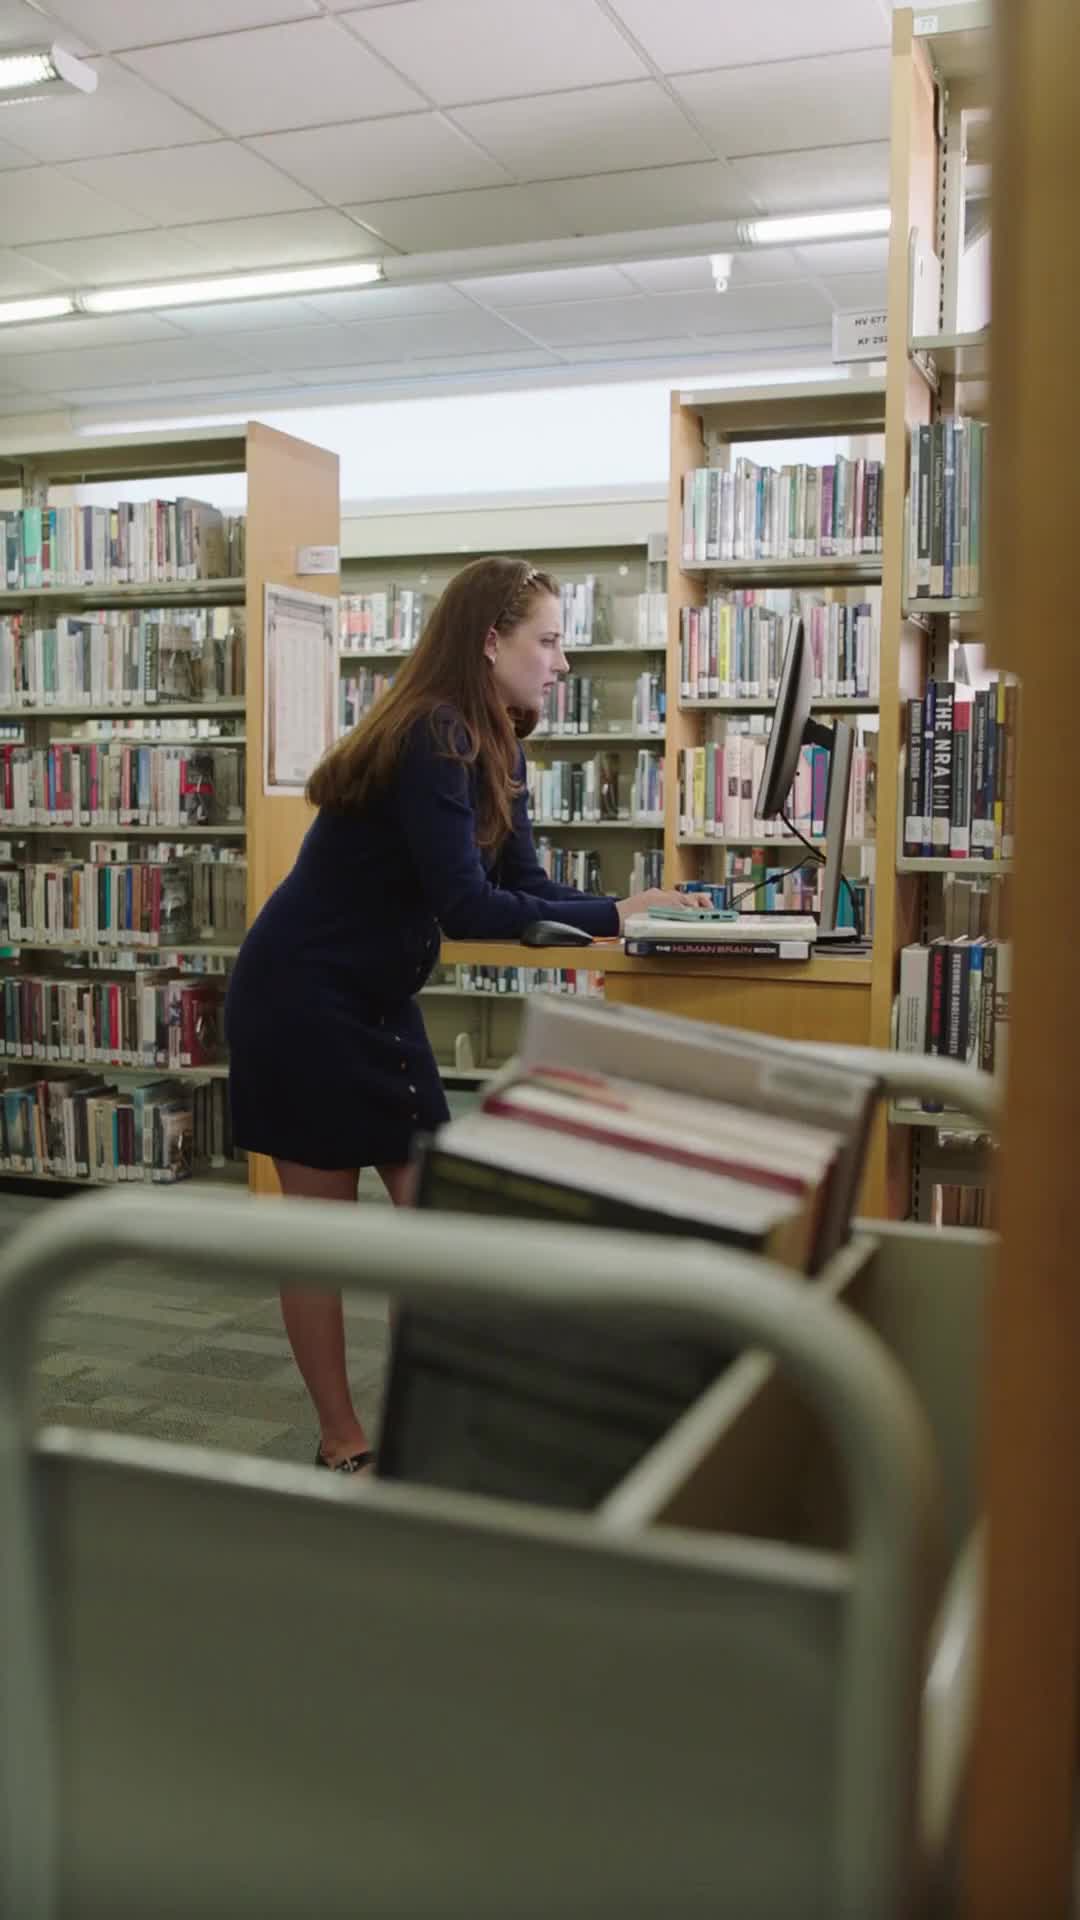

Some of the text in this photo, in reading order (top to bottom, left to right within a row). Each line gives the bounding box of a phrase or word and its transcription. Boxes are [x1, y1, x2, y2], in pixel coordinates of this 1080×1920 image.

[935, 694, 953, 731] THE
[933, 739, 952, 778] NRA
[671, 944, 716, 953] HUMAN
[716, 944, 753, 953] BRAIN
[952, 953, 961, 994] BECOMING
